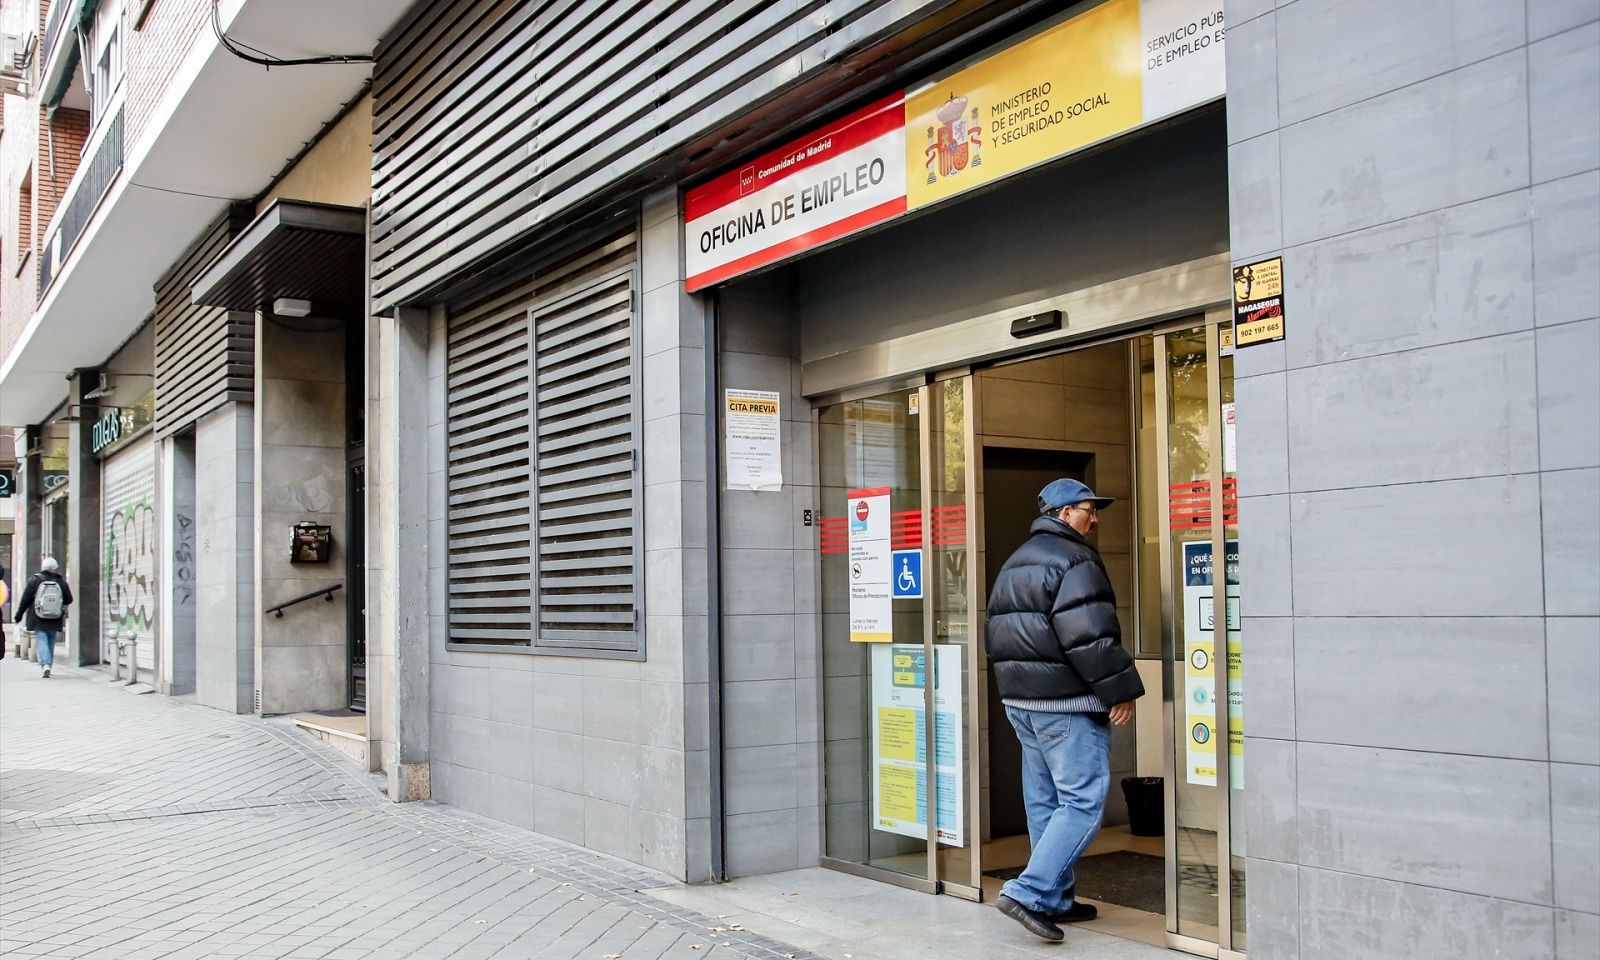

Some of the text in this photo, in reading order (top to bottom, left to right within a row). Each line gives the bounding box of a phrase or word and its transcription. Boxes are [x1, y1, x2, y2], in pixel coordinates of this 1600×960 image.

[1147, 23, 1197, 53] SERVICIO
[1147, 54, 1163, 70] DE
[1166, 35, 1210, 63] EMPLEO
[991, 81, 1051, 117] MINISTERIO
[992, 99, 1050, 133] DE EMPLEO
[992, 91, 1110, 149] Y SEGURIDAD SOCIAL
[758, 140, 832, 179] Comunidad de Madrid
[700, 157, 885, 254] OFICINA DE EMPLEO
[1241, 329, 1253, 338] 902
[1254, 326, 1265, 335] 197
[729, 403, 776, 414] CITA PREVIA
[1190, 553, 1207, 564] ¿QUÉ
[1191, 567, 1201, 575] EN
